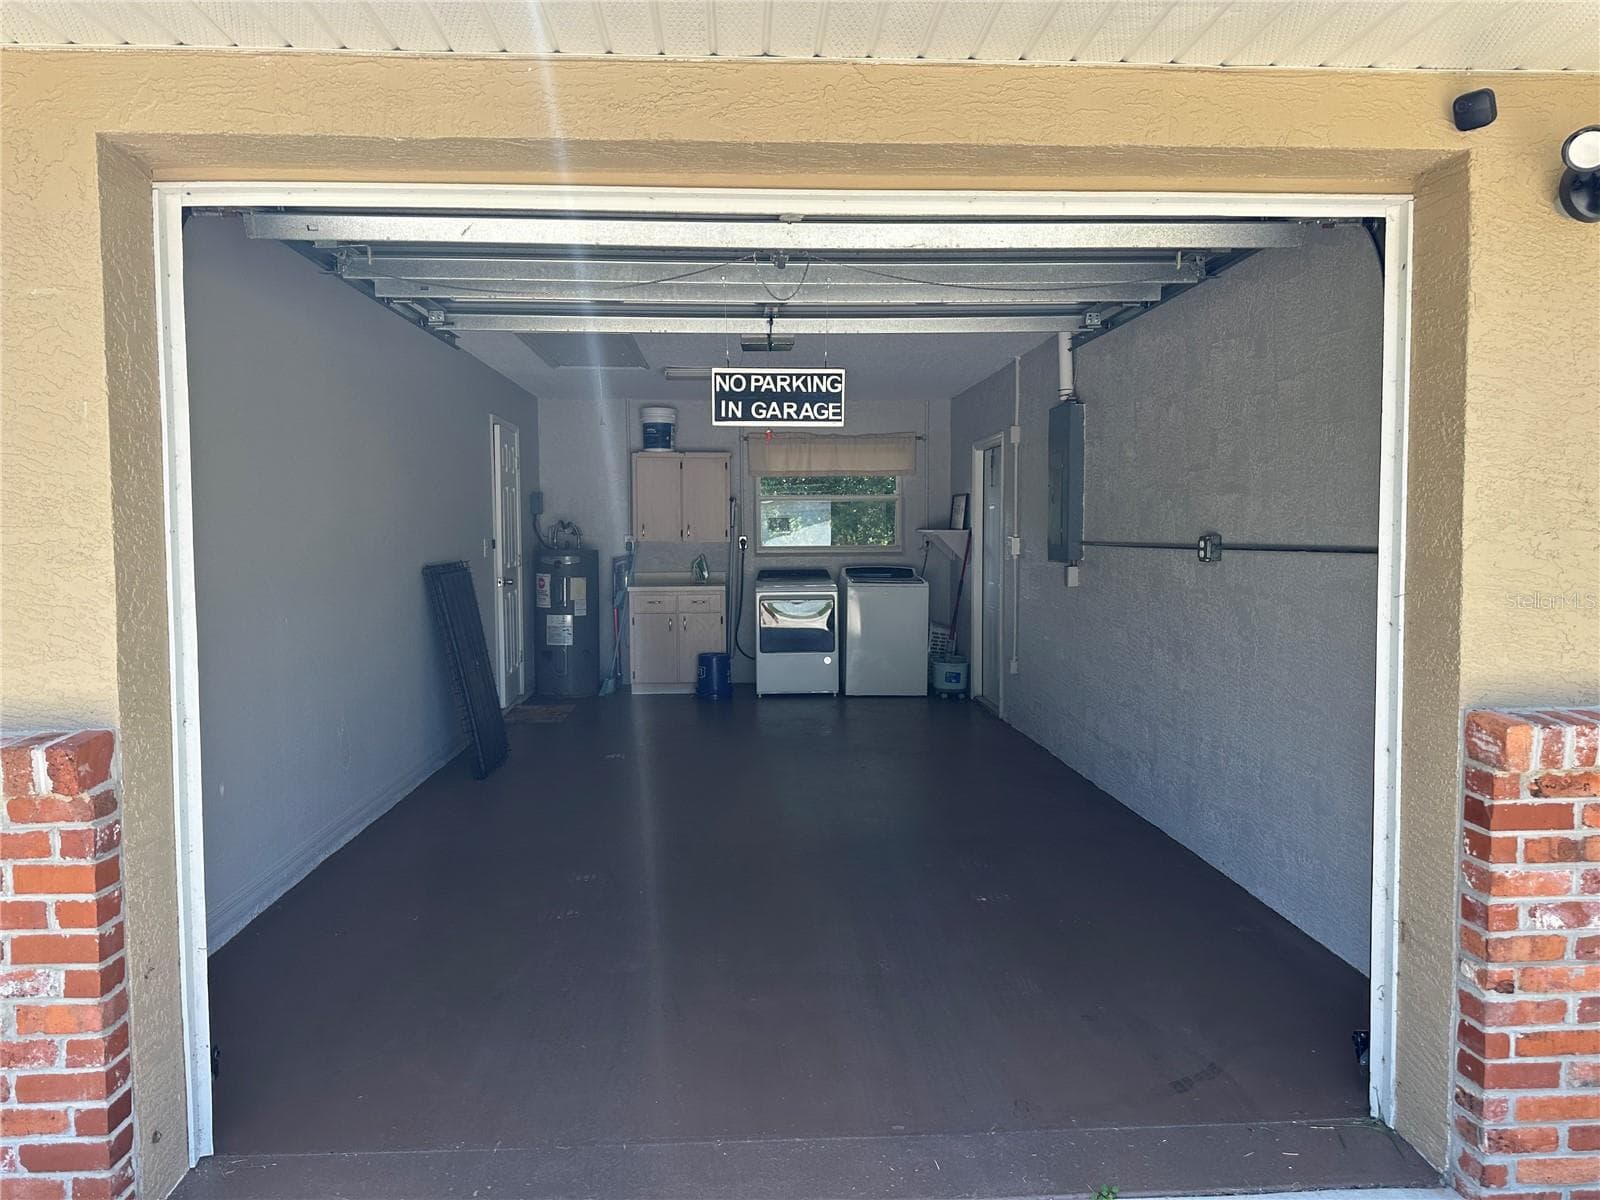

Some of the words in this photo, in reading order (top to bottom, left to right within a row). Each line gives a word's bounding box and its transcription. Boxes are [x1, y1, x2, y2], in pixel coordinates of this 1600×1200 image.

[716, 375, 746, 393] NO
[750, 375, 842, 393] PARKING
[721, 400, 742, 418] IN
[751, 401, 842, 420] GARAGE
